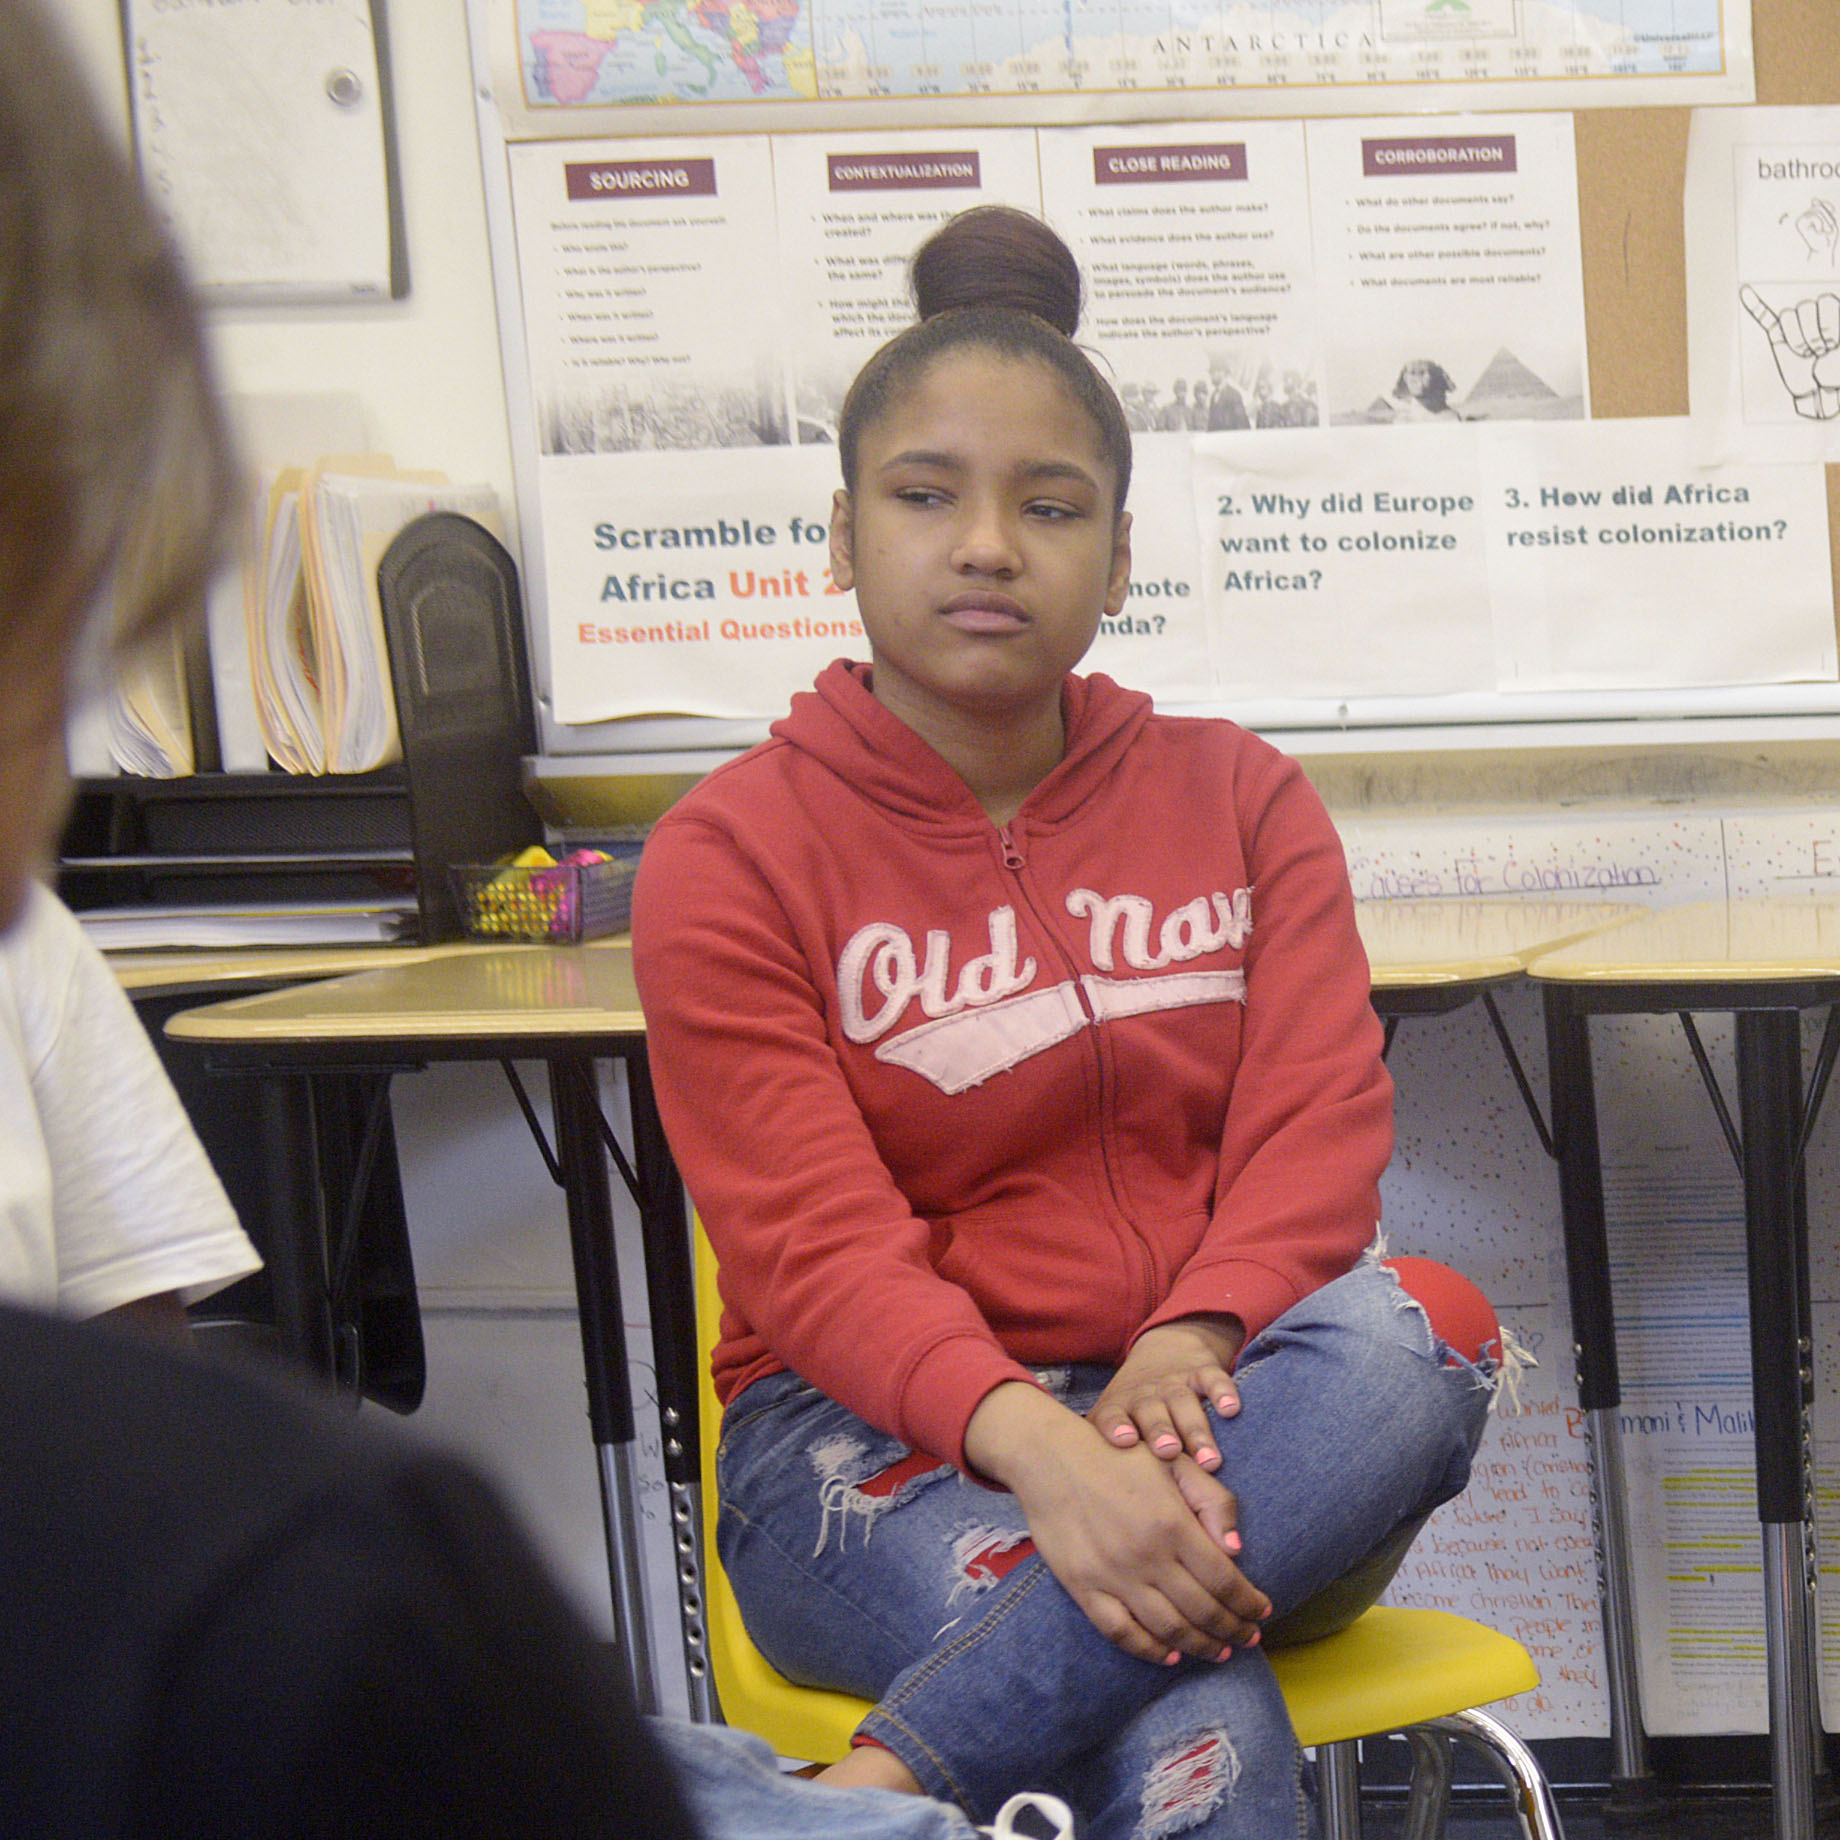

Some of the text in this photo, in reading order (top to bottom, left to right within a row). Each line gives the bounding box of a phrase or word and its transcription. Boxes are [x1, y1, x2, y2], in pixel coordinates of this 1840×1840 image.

[1109, 155, 1231, 172] CLOSE READING
[1375, 148, 1503, 164] CORROBORATION
[590, 169, 689, 190] SOURCING
[835, 163, 973, 180] CONTEXTUALIZATION
[1356, 194, 1514, 206] What do other documents say?
[1088, 203, 1268, 216] What claims does the author make?
[1357, 224, 1372, 234] Do
[1373, 224, 1391, 233] the
[1393, 224, 1450, 232] documents
[1453, 221, 1487, 232] agree?
[1524, 219, 1550, 230] why?
[1090, 229, 1274, 244] What evidence does the author use?
[1359, 246, 1546, 260] What are other possible documents?
[1092, 263, 1168, 272] What language
[1361, 278, 1387, 286] What
[1390, 277, 1447, 286] documents
[1469, 275, 1495, 284] most
[1498, 273, 1541, 283] reliable?
[1121, 316, 1146, 325] does
[1149, 316, 1165, 324] the
[1230, 313, 1278, 323] language
[1505, 484, 1749, 509] 3. How did Africa
[1218, 492, 1473, 519] 2. Why did Europe
[594, 517, 826, 549] Scramble fo
[1220, 530, 1457, 553] want to colonize
[1508, 520, 1787, 546] resist colonization?
[600, 573, 714, 601] Africa
[729, 570, 809, 598] Unit
[1224, 570, 1322, 591] Africa?
[578, 614, 868, 643] Essential Questions
[837, 887, 1255, 1044] Old Nav
